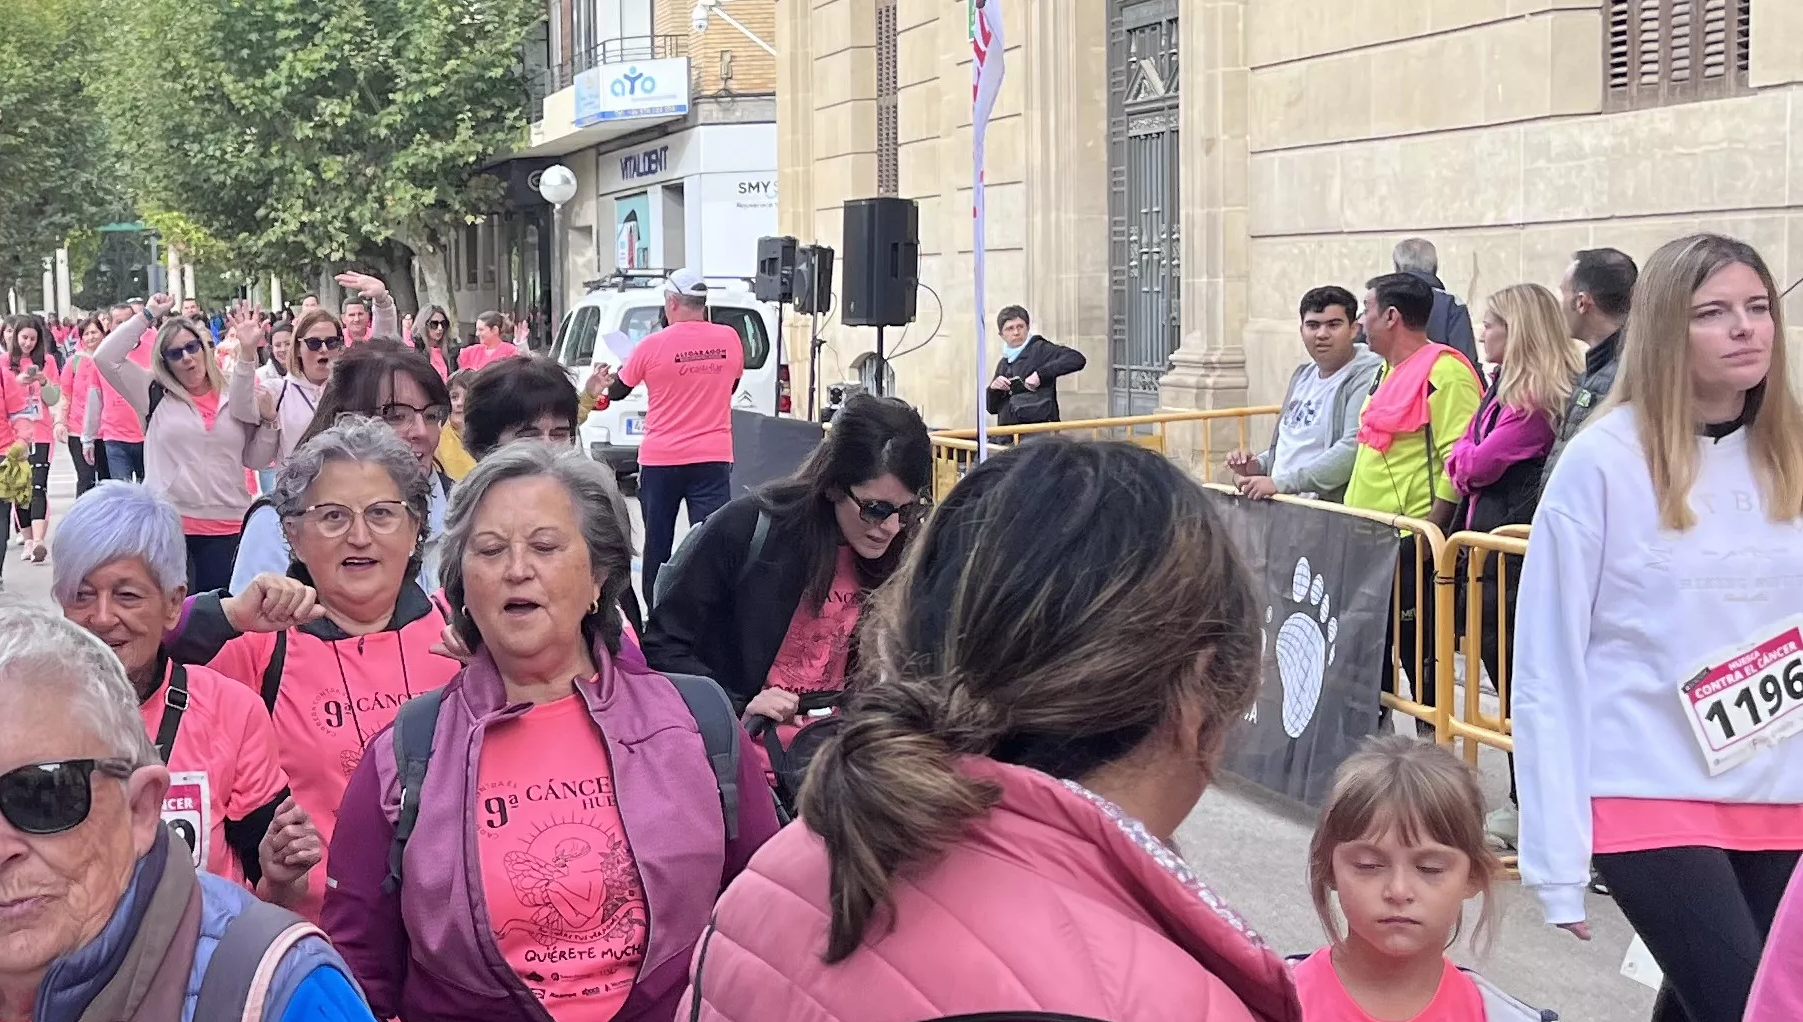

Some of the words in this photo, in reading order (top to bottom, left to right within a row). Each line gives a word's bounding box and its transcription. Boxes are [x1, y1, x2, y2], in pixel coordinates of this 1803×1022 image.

[620, 145, 669, 181] VITALDENT
[1694, 670, 1744, 699] CONTRA
[1743, 663, 1758, 677] EL
[1756, 641, 1798, 668] CÁNCER
[356, 691, 411, 713] CÁNC
[1704, 657, 1803, 740] 1196
[525, 776, 613, 802] CÁNCE
[524, 946, 597, 963] QUIÉRETE
